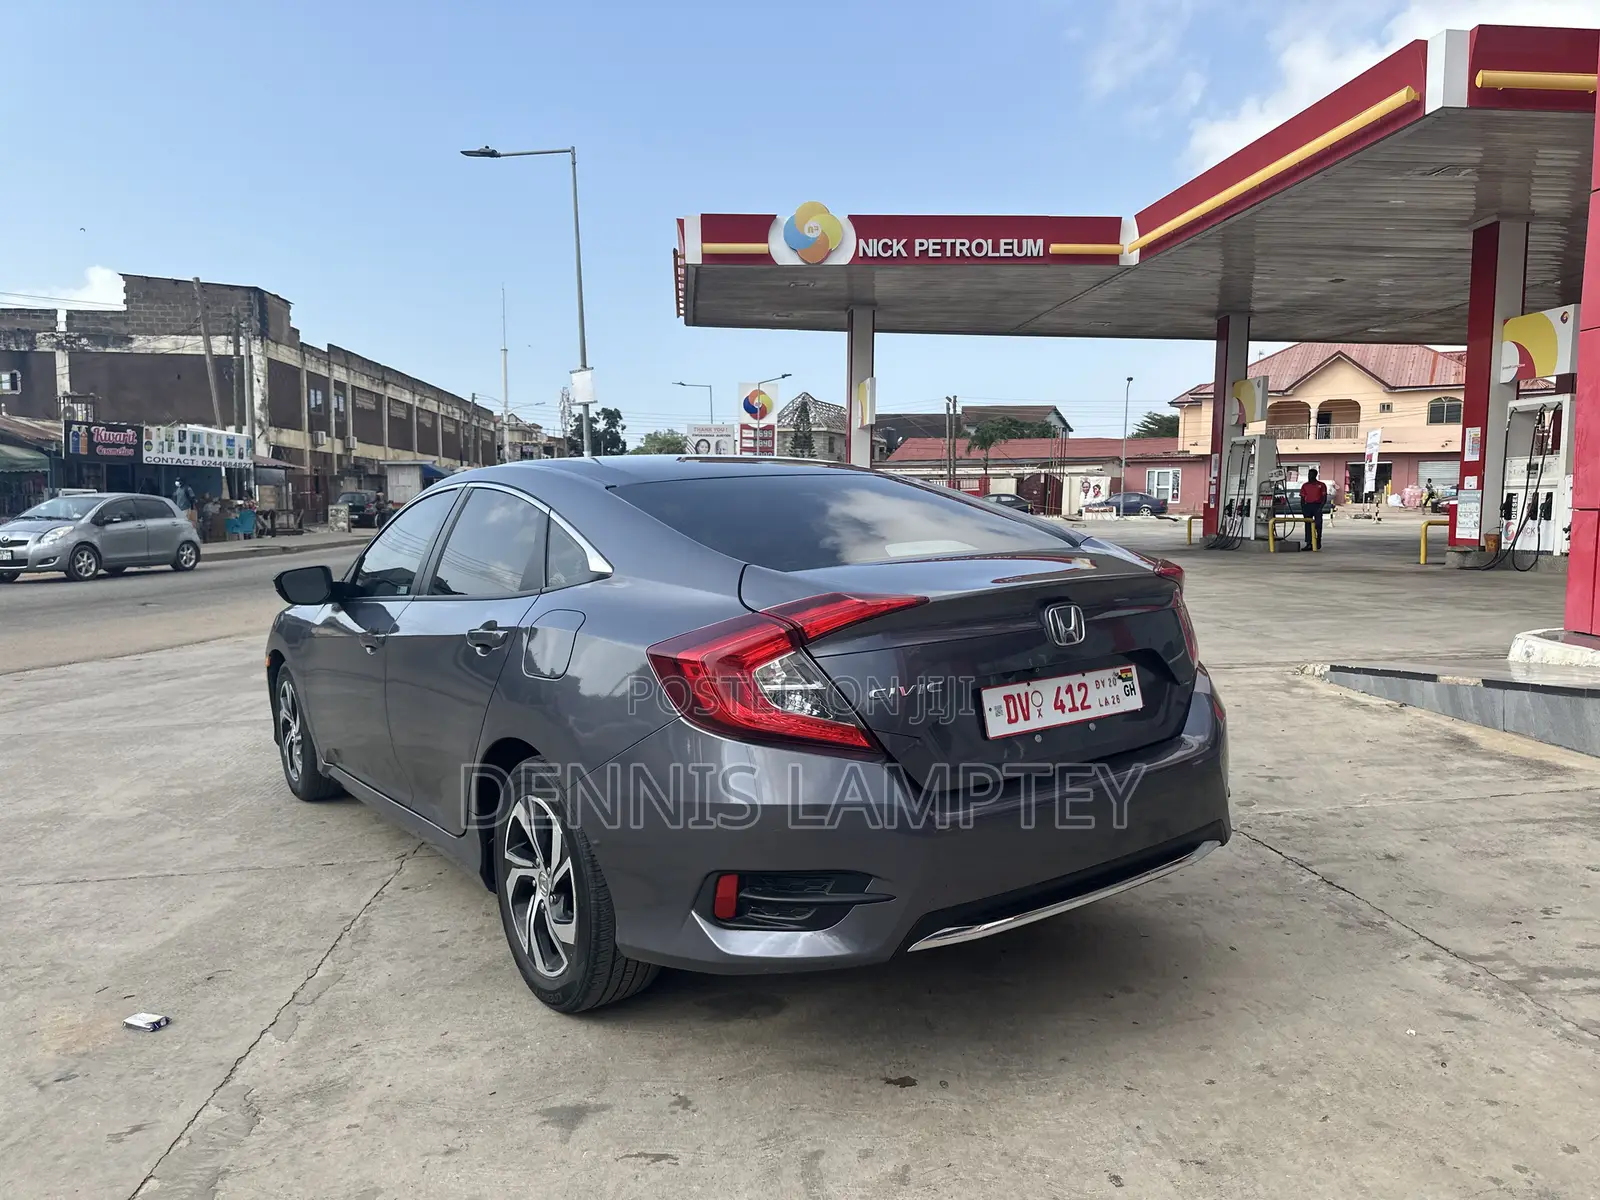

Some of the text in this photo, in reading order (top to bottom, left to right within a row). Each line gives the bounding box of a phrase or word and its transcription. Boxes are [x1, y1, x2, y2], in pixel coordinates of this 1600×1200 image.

[858, 238, 1044, 258] NICK PETROLEUM
[145, 456, 199, 466] CONTACT:
[868, 681, 943, 700] CIVIC
[1123, 683, 1136, 697] GH
[1003, 691, 1031, 724] DV
[1053, 682, 1091, 714] 412
